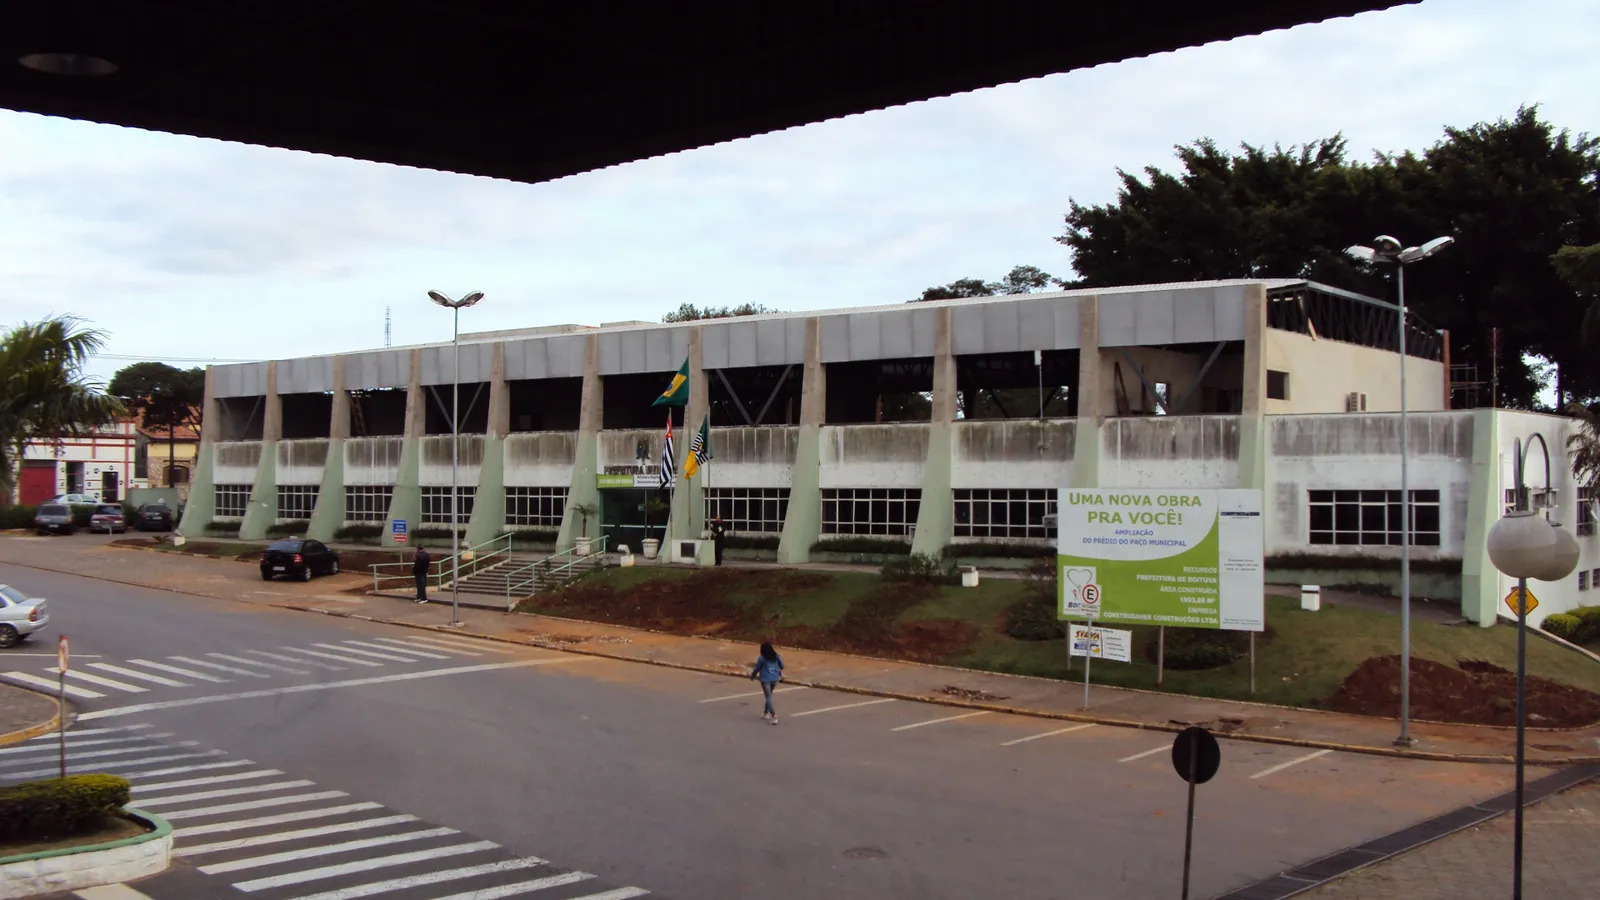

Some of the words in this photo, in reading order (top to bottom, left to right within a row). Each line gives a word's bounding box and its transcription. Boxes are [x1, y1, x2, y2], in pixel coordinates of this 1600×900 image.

[1109, 495, 1152, 506] NOVA
[1157, 495, 1202, 507] OBRA
[1088, 511, 1123, 524] PRA
[1128, 508, 1182, 526] VOCÊ!
[1115, 529, 1154, 537] AMPLIAÇÃO
[1093, 537, 1118, 545] PRÉDIO
[1136, 574, 1176, 582] PREFEITURA
[1160, 585, 1177, 593] ÁREA
[1087, 588, 1094, 600] E
[1103, 612, 1152, 620] CONSTRUDAHER
